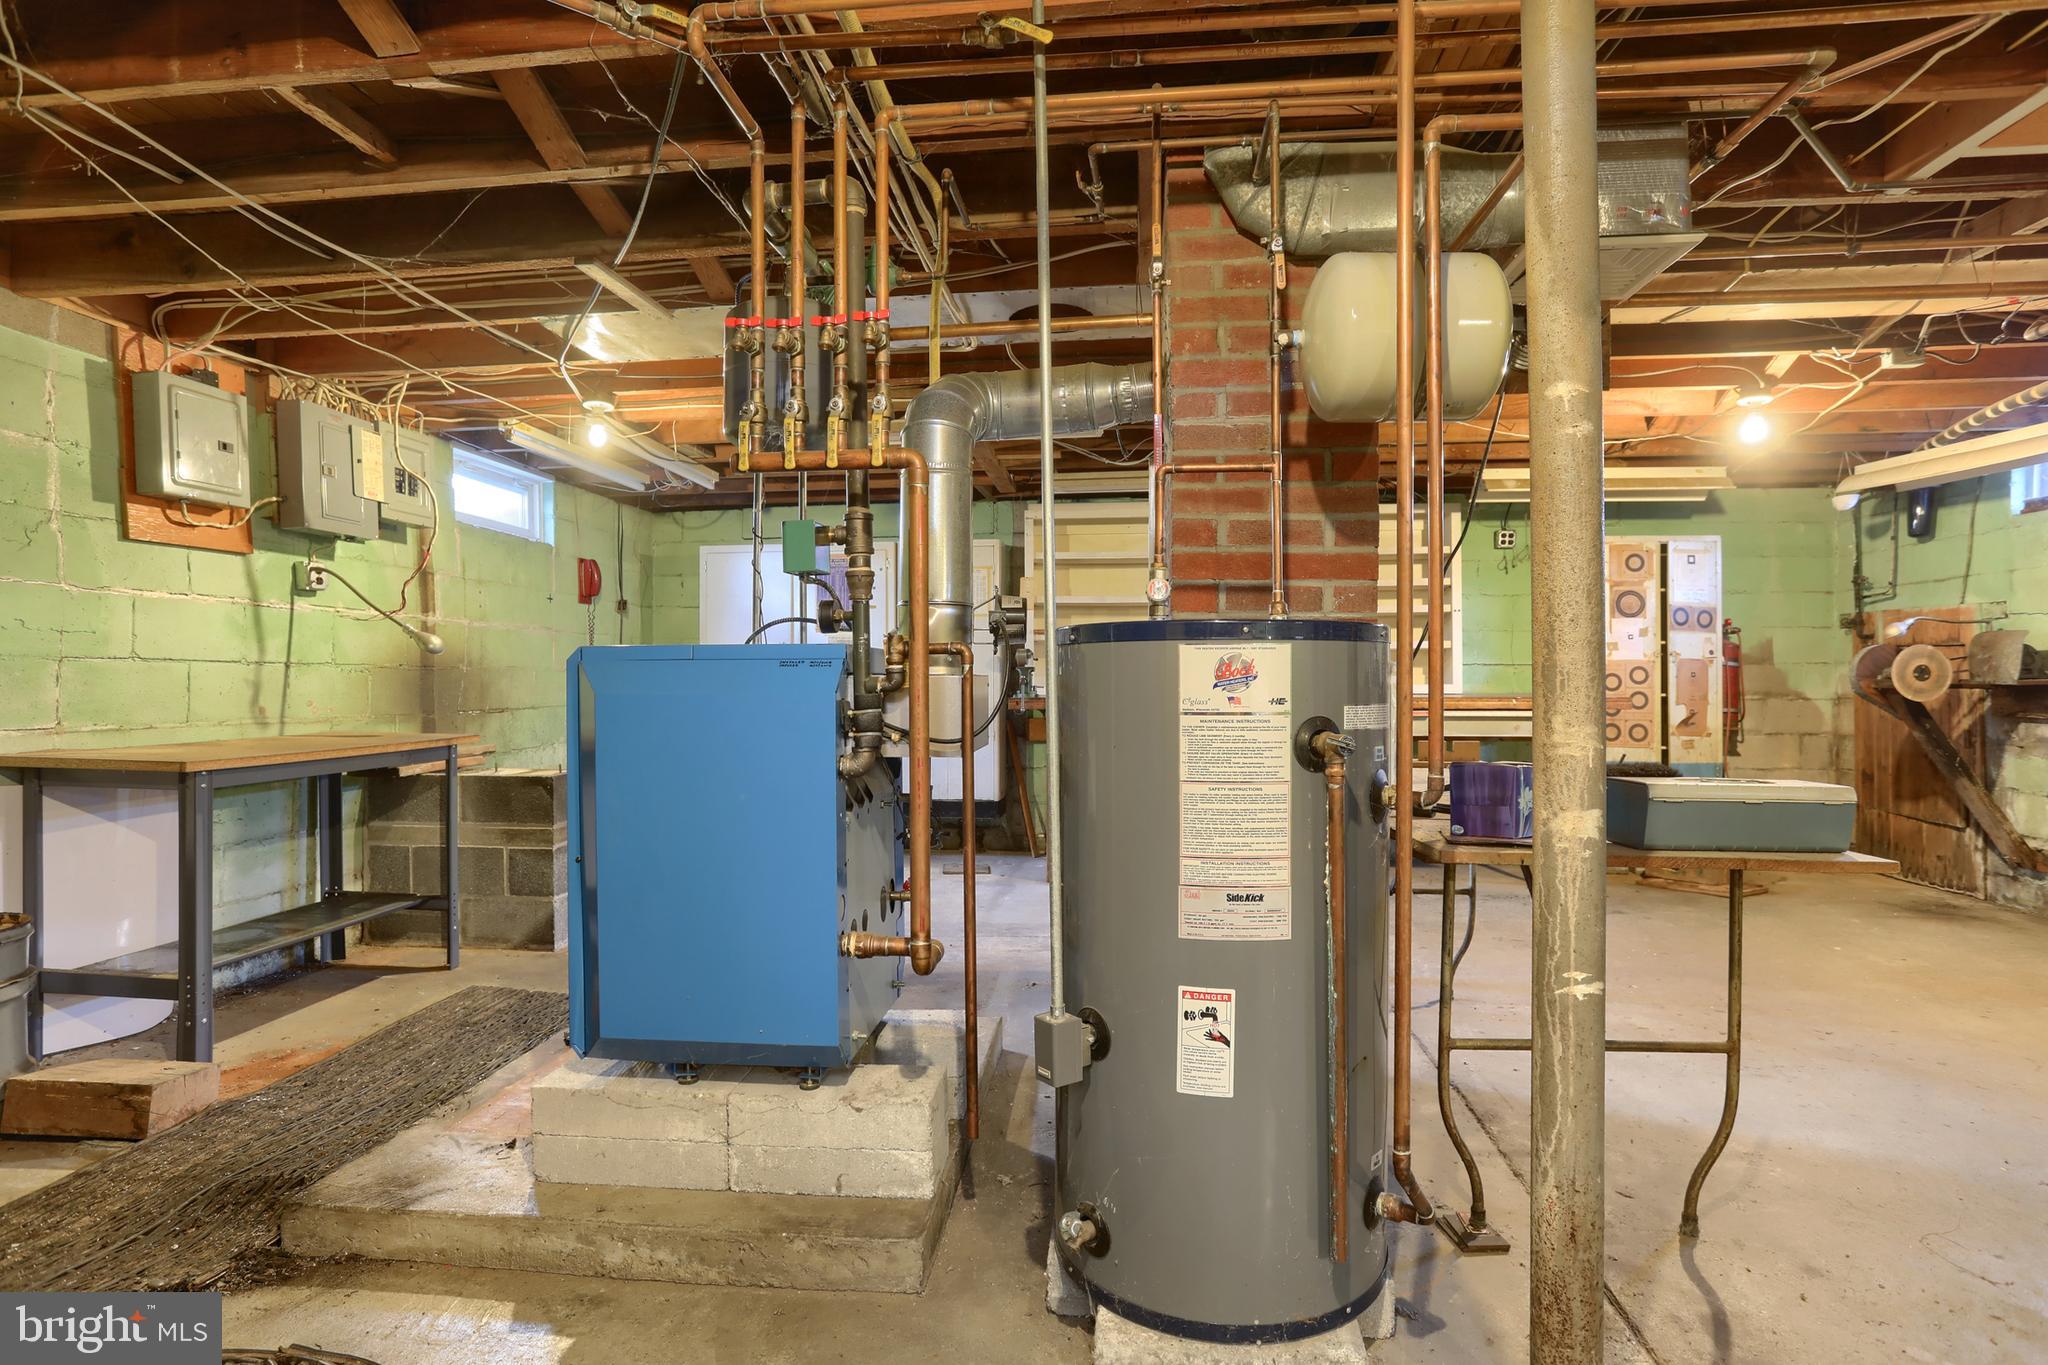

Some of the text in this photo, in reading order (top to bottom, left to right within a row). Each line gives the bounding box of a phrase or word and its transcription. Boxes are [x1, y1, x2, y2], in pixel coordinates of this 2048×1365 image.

[1216, 658, 1256, 680] Bock
[1226, 893, 1265, 902] SideKick
[1193, 992, 1230, 1001] DANGER
